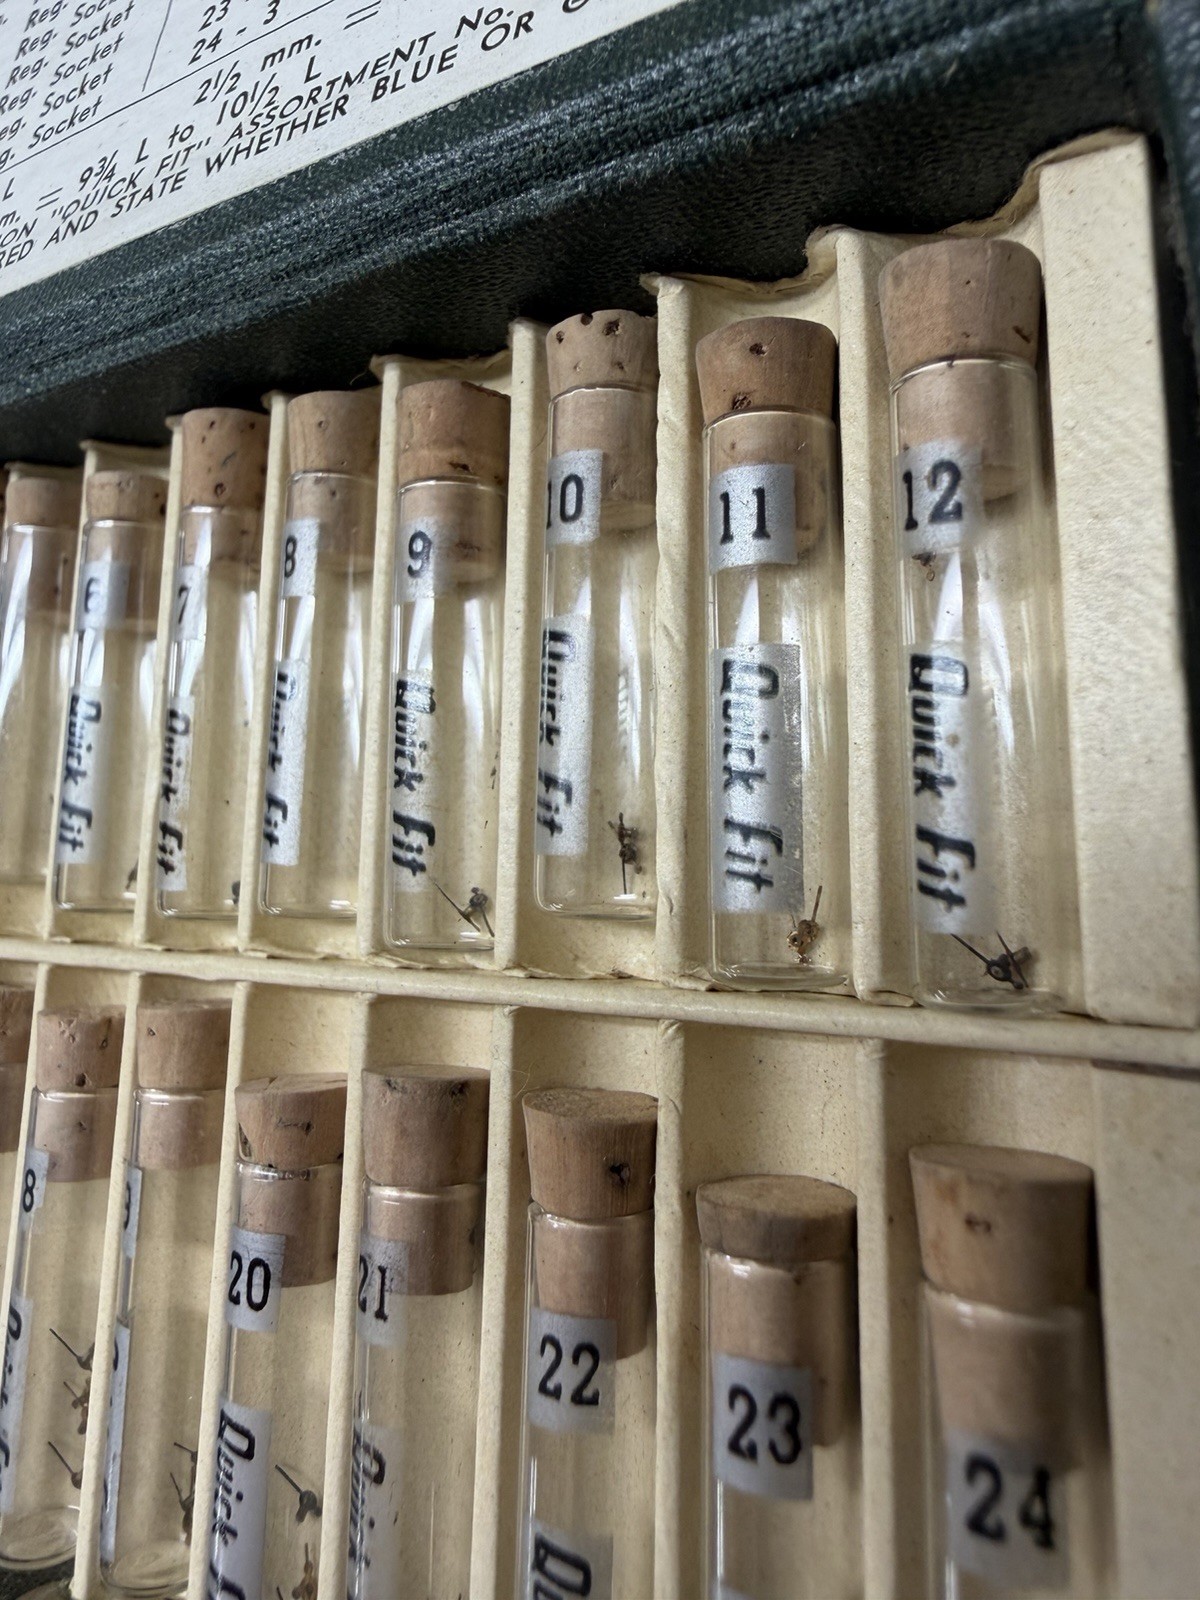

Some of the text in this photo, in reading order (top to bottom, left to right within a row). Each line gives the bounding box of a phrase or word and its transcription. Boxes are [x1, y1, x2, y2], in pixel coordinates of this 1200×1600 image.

[5, 0, 135, 90] Reg. Socket
[14, 28, 58, 61] Reg.
[24, 1, 68, 32] Reg.
[188, 28, 223, 66] 24
[263, 0, 280, 25] 3
[0, 31, 124, 116] Reg. Socket
[0, 63, 114, 141] eg. Socket
[135, 137, 149, 165] L
[169, 124, 194, 149] to
[304, 55, 321, 84] L
[0, 217, 38, 248] ON
[222, 31, 436, 147] ASSORTMENT
[454, 7, 514, 39] No.
[3, 177, 15, 200] L
[260, 34, 322, 72] mm.
[28, 95, 102, 149] Socket
[43, 209, 99, 250] AND
[110, 168, 190, 218] STATE
[205, 94, 350, 177] WHETHER
[371, 44, 458, 103] BLUE
[480, 10, 535, 52] OR
[719, 486, 771, 544] 11
[901, 458, 964, 531] 12
[284, 536, 298, 578] 8
[407, 530, 432, 578] 9
[392, 679, 436, 877] Quick Fit
[537, 771, 573, 838] Fit
[720, 658, 783, 893] Quick Fit
[908, 653, 976, 913] Quick Fit
[57, 800, 93, 852] Fit
[156, 820, 184, 876] Fit
[262, 792, 288, 849] Fit
[228, 1251, 271, 1312] 20
[359, 1255, 389, 1322] 21
[537, 1334, 600, 1407] 22
[727, 1385, 802, 1465] 23
[213, 1409, 256, 1547] Quick
[965, 1453, 1055, 1549] 24
